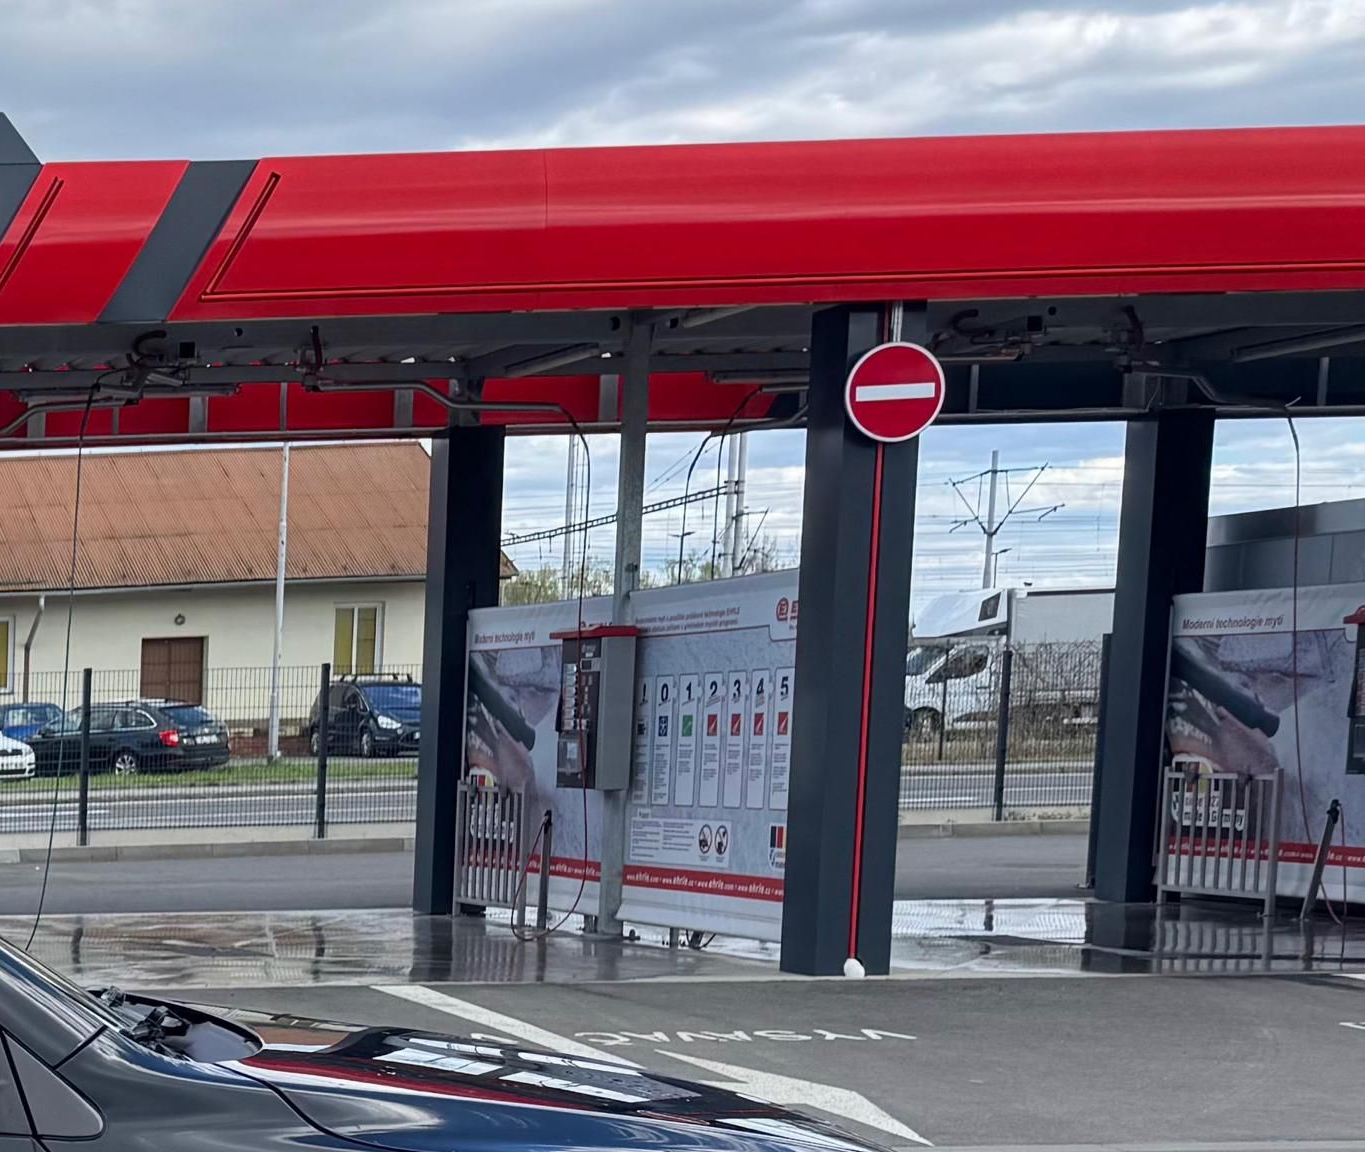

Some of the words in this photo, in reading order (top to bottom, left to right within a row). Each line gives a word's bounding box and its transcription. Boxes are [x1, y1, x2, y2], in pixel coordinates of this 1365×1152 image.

[685, 681, 692, 701] 1
[709, 680, 718, 697] 2
[733, 679, 742, 698] 3
[756, 677, 765, 695] 4
[780, 675, 789, 697] 5
